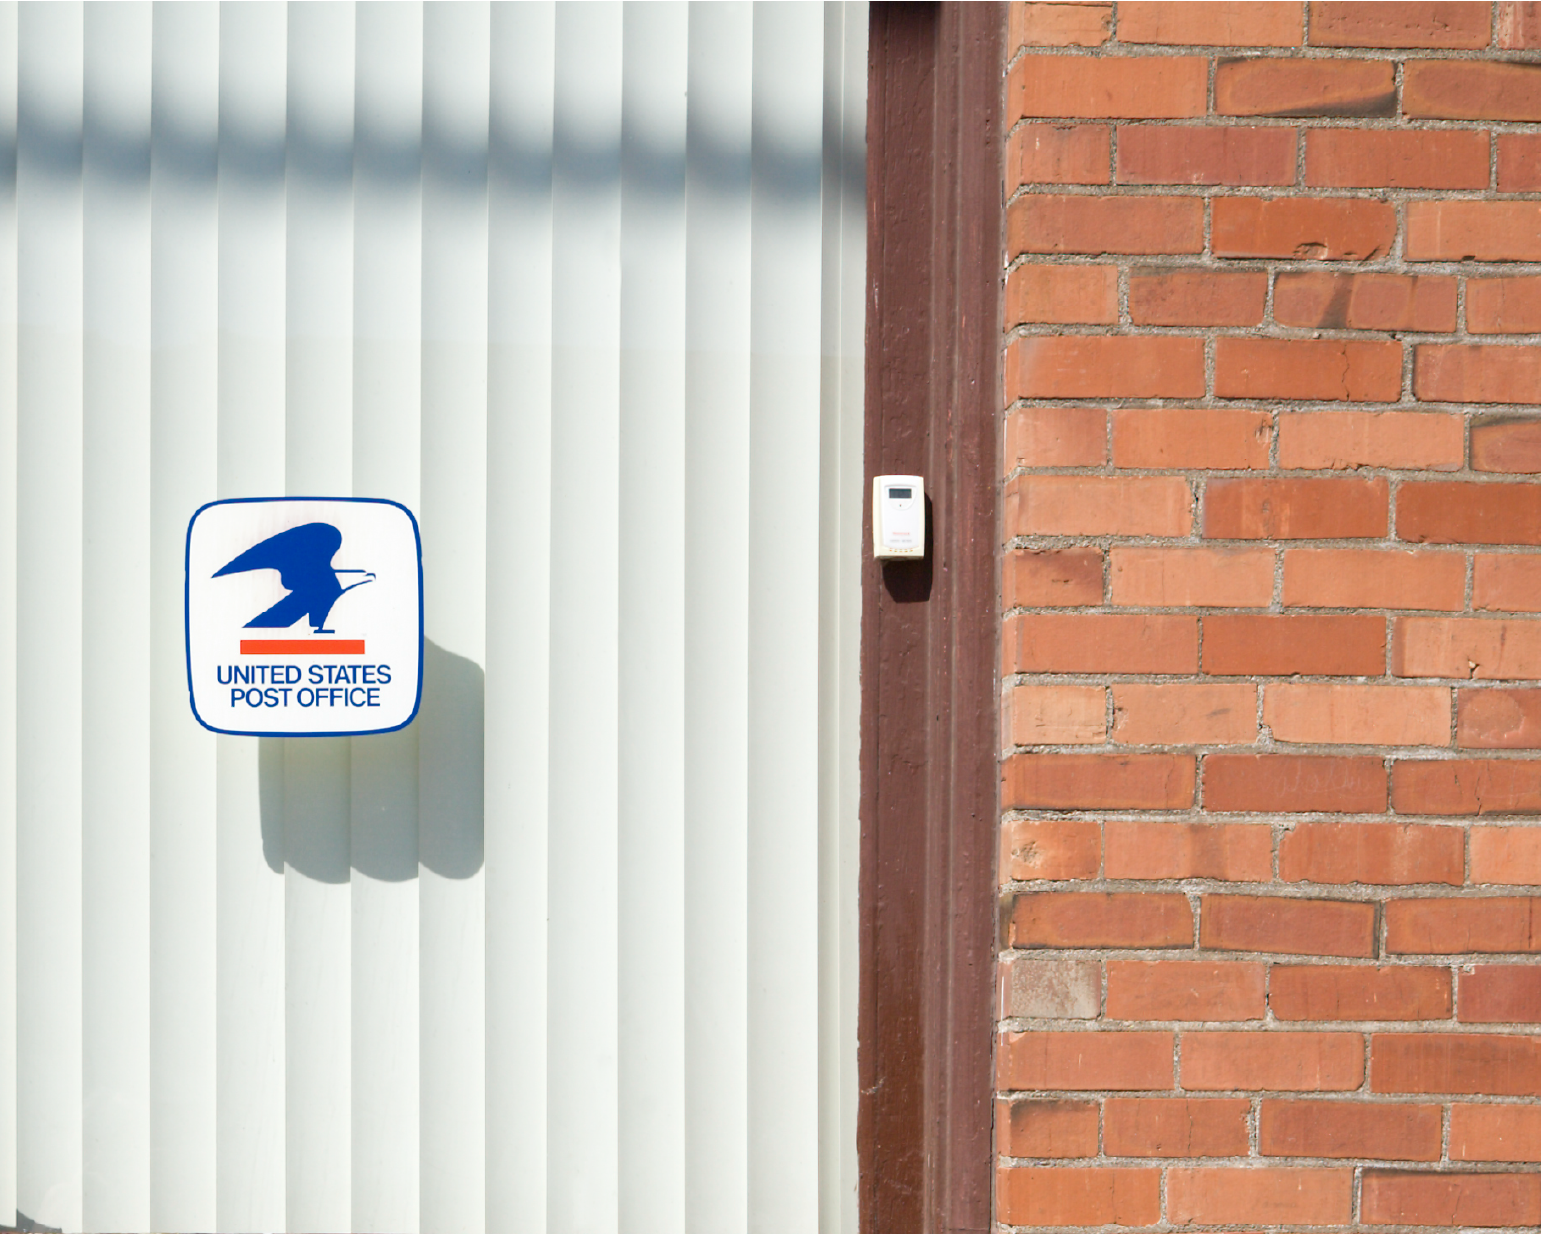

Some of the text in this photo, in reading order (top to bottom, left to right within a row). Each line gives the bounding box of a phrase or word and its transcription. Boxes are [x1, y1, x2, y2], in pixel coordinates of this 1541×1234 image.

[217, 664, 392, 685] UNITED STATES
[231, 687, 381, 708] POST OFFICE
